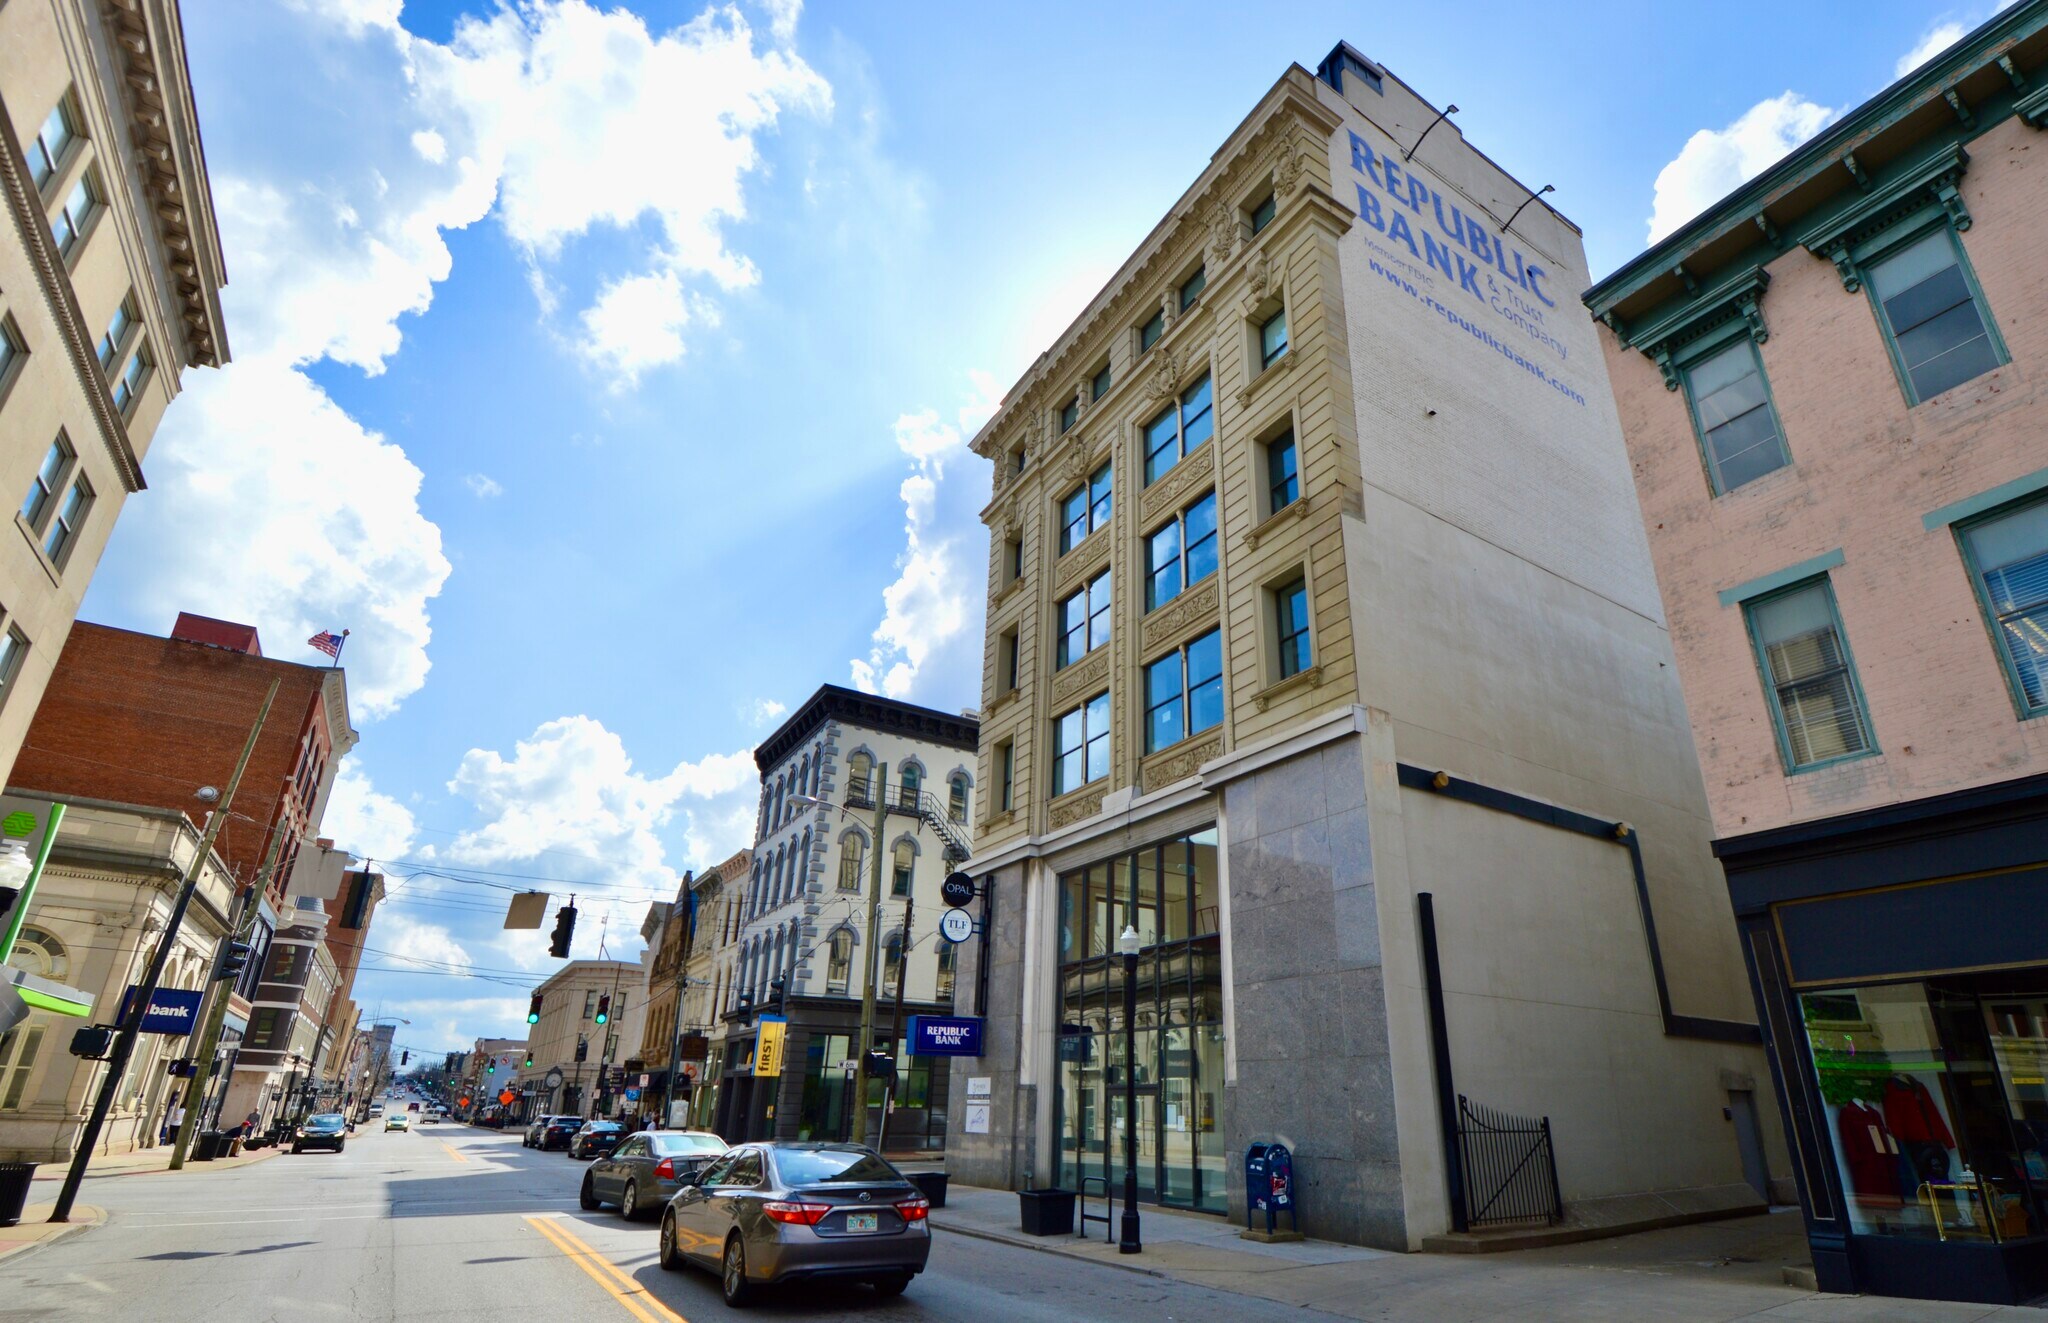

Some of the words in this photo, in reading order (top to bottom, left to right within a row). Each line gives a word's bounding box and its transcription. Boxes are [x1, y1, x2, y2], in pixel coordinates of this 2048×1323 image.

[1346, 128, 1555, 308] REPUBLIC
[1354, 181, 1486, 304] BANK
[1407, 264, 1435, 289] FDIC
[1487, 273, 1500, 295] &
[1503, 284, 1545, 326] Trust
[1368, 257, 1586, 407] www.republicbank.com
[1490, 295, 1568, 361] Company
[946, 883, 972, 896] OPAL
[947, 919, 968, 930] TLF
[926, 1025, 970, 1037] REPUBLIC
[935, 1035, 961, 1045] BANK
[627, 1090, 638, 1098] 75
